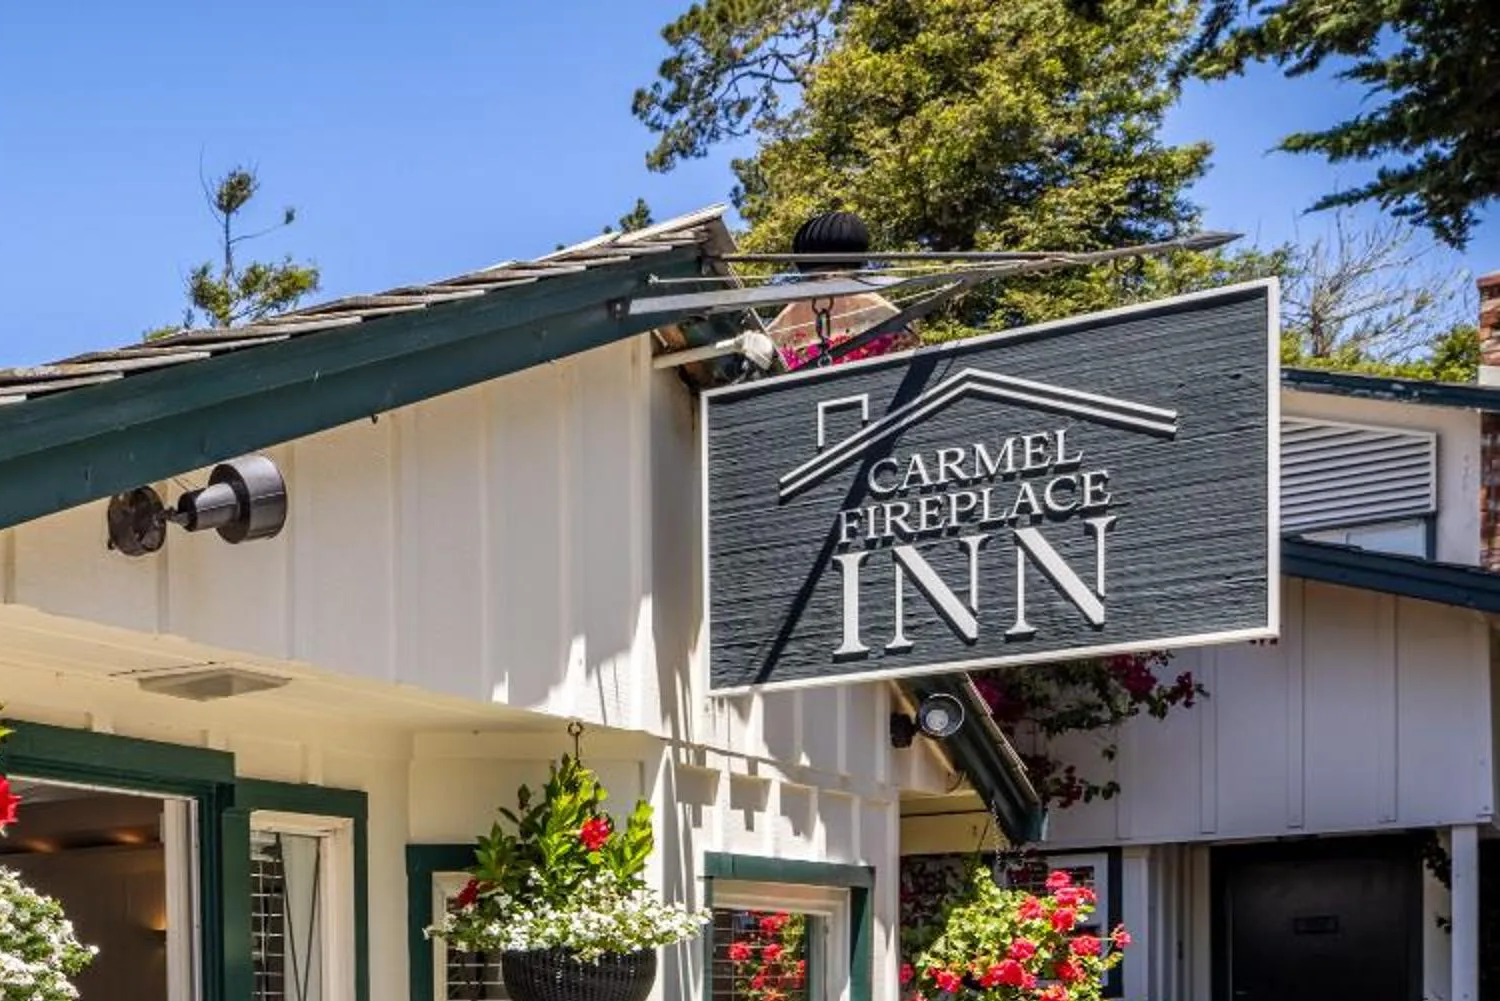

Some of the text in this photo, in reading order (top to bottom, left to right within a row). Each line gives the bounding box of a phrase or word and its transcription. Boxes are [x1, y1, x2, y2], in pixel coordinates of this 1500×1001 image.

[867, 428, 1084, 497] CARMEL
[837, 468, 1114, 546] FIREPLACE
[831, 515, 1118, 658] INN
